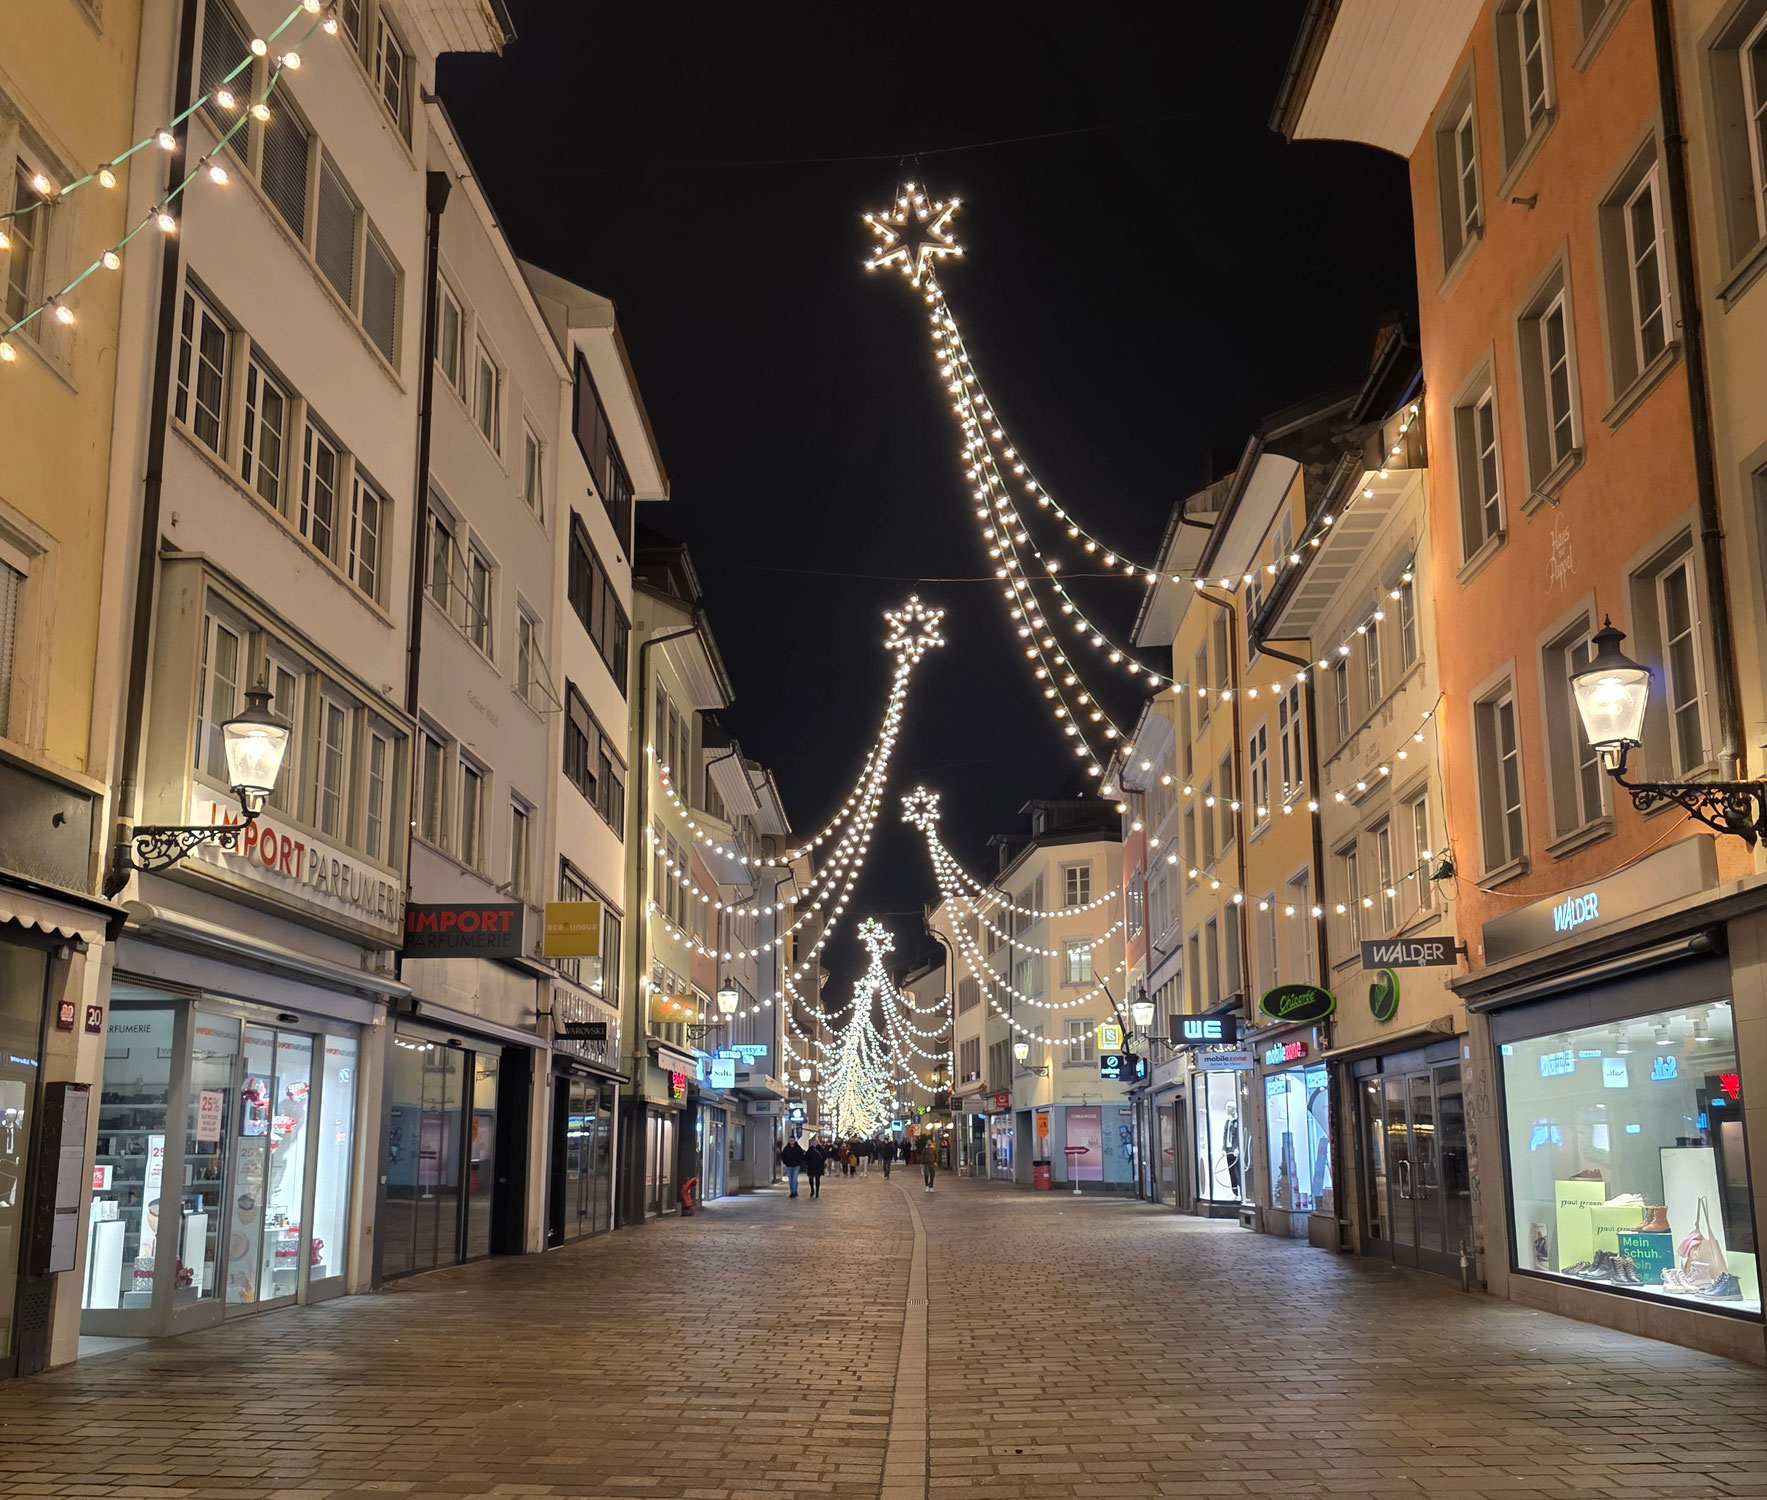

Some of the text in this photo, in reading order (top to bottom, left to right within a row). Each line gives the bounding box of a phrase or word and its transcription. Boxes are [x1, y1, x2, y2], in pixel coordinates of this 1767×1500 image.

[211, 803, 305, 878] IMPORT
[1553, 892, 1599, 932] WALDER
[408, 911, 514, 932] IMPORT
[406, 933, 512, 949] PARFUMERIE
[1373, 942, 1445, 964] WALDER
[88, 1008, 101, 1026] 20
[1184, 1020, 1222, 1039] WE
[714, 1069, 732, 1077] Salt.
[202, 1096, 219, 1112] 25%
[1560, 1200, 1578, 1208] paul
[1597, 1226, 1615, 1235] paul
[1623, 1237, 1649, 1247] Mein
[1624, 1248, 1661, 1259] Schuh.
[1634, 1260, 1651, 1270] ein
